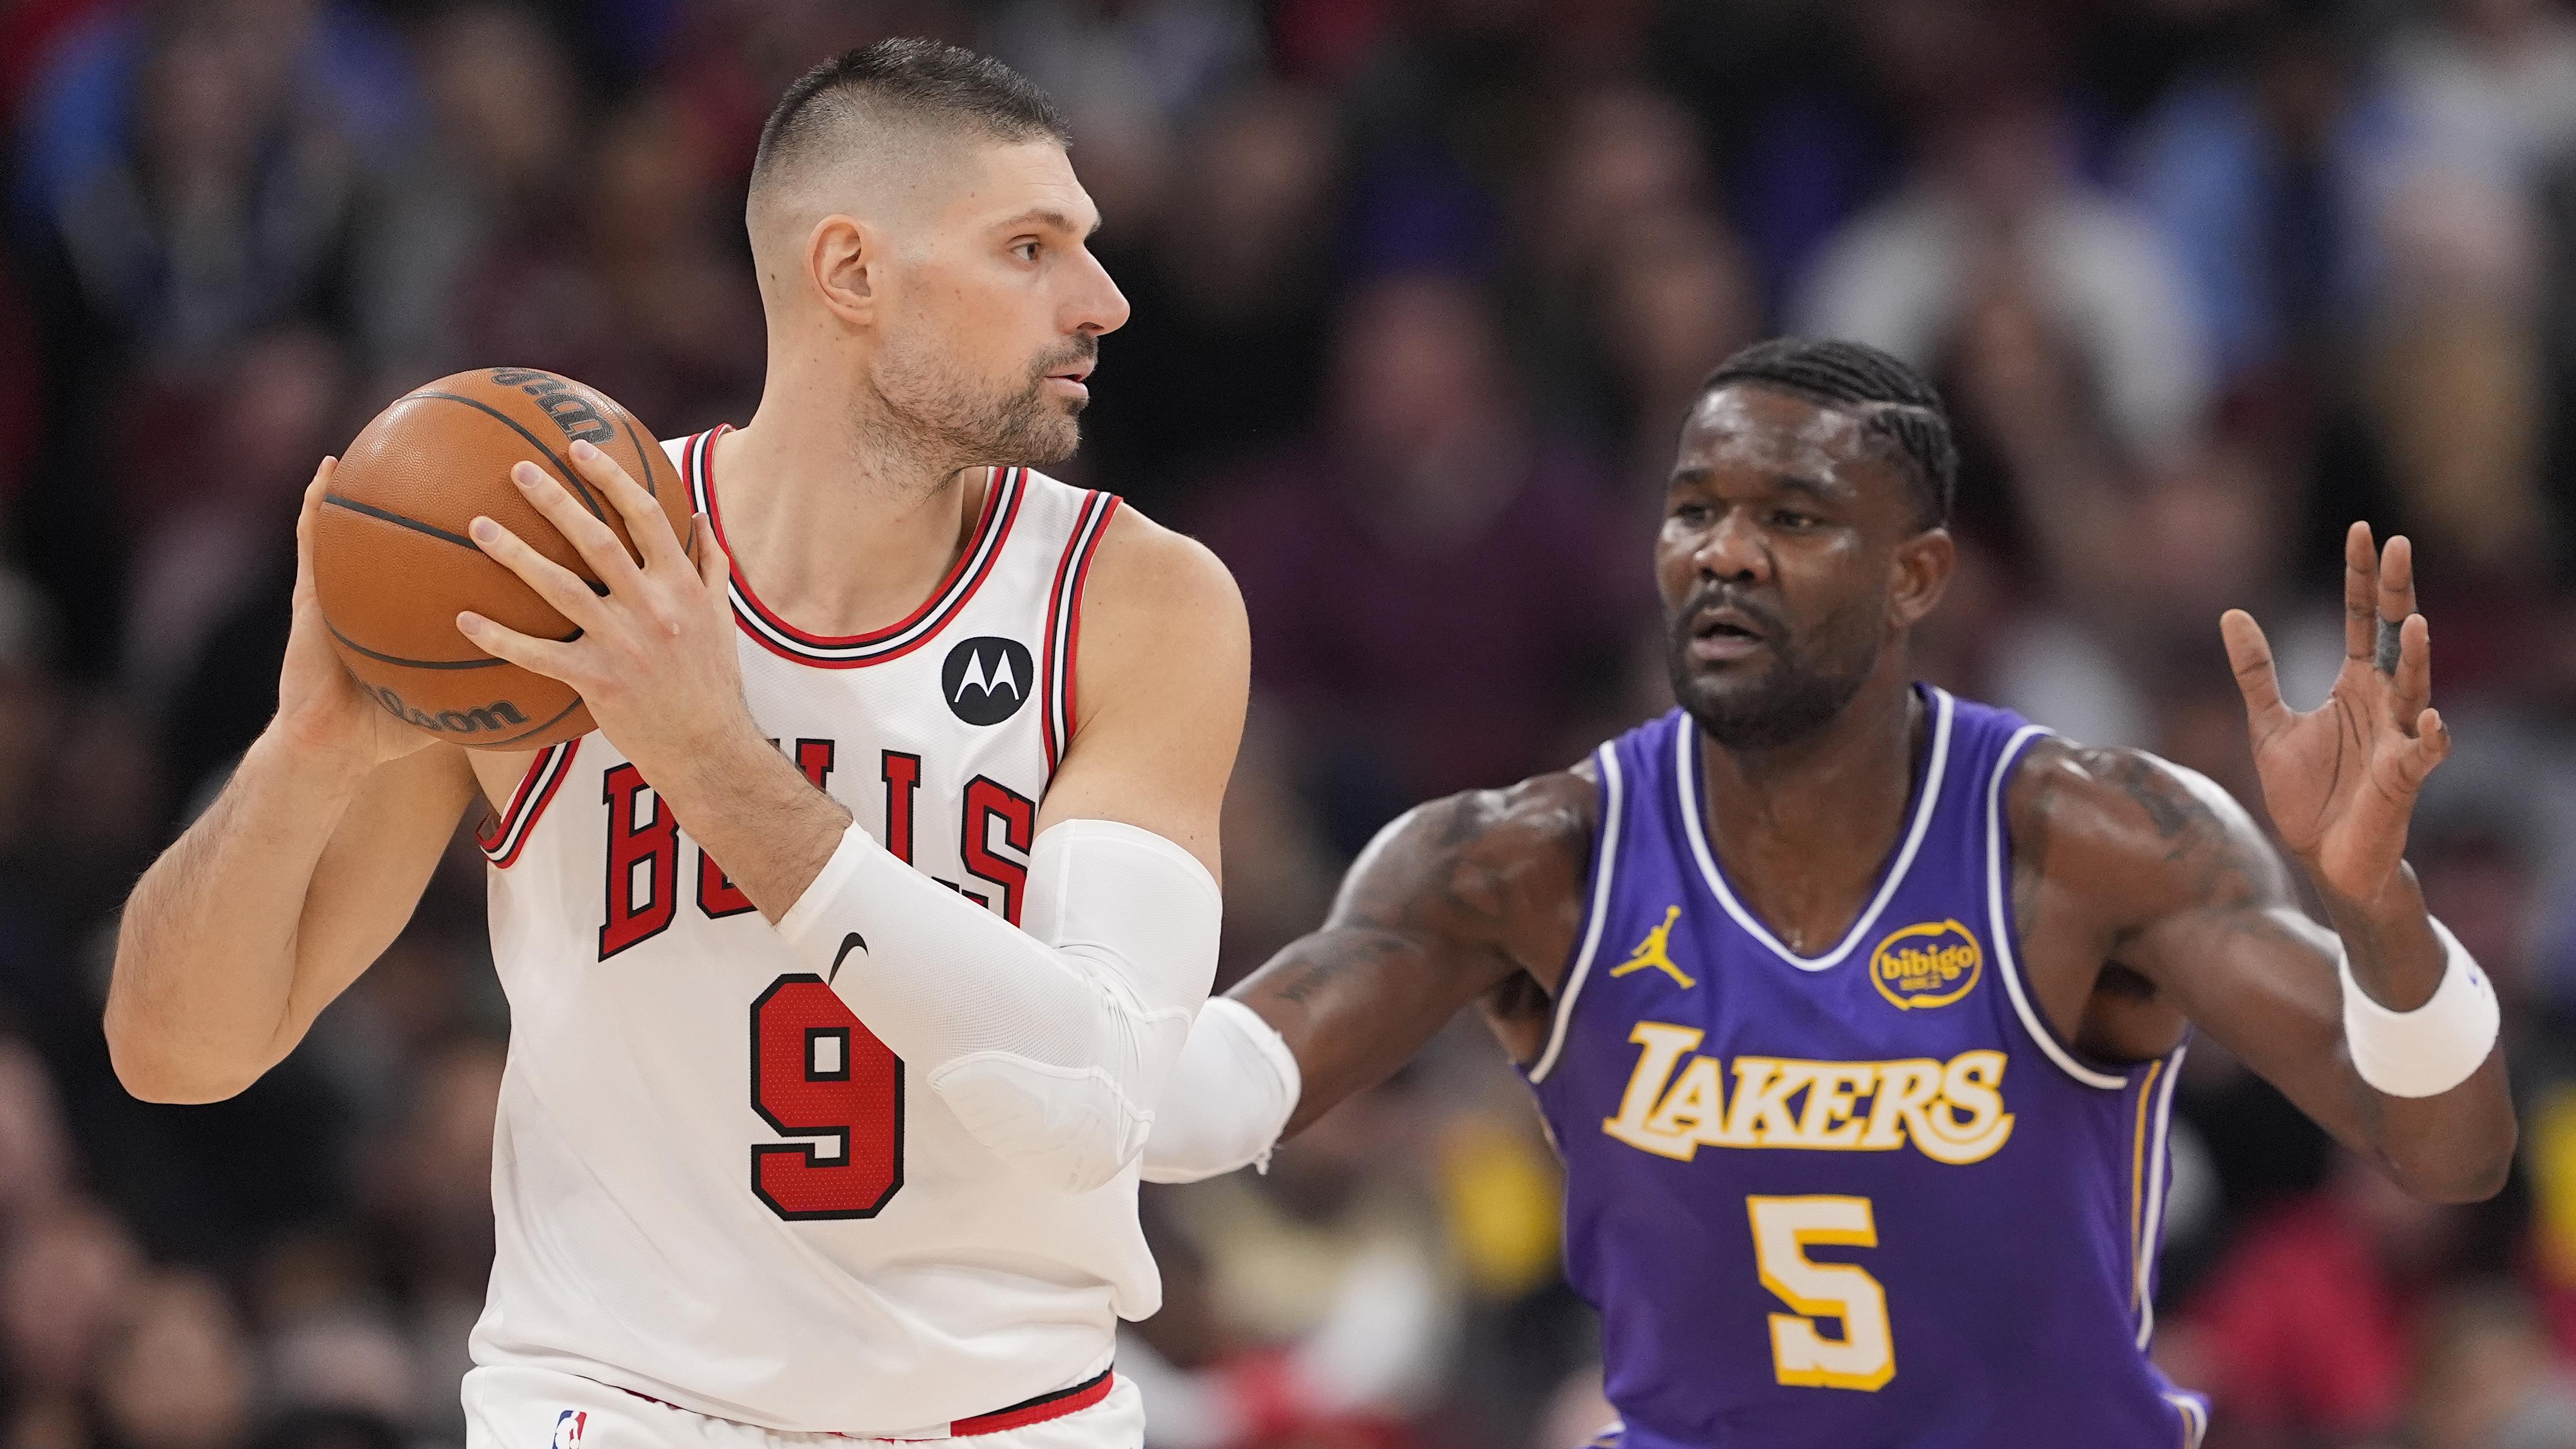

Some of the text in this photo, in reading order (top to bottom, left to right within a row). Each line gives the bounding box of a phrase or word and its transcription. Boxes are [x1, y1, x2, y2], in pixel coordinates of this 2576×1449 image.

[598, 738, 1035, 962] BLS
[1881, 943, 1974, 980] bibigo
[750, 973, 904, 1221] 9
[1603, 1022, 2015, 1165] LAKERS
[1747, 1195, 1896, 1392] 5
